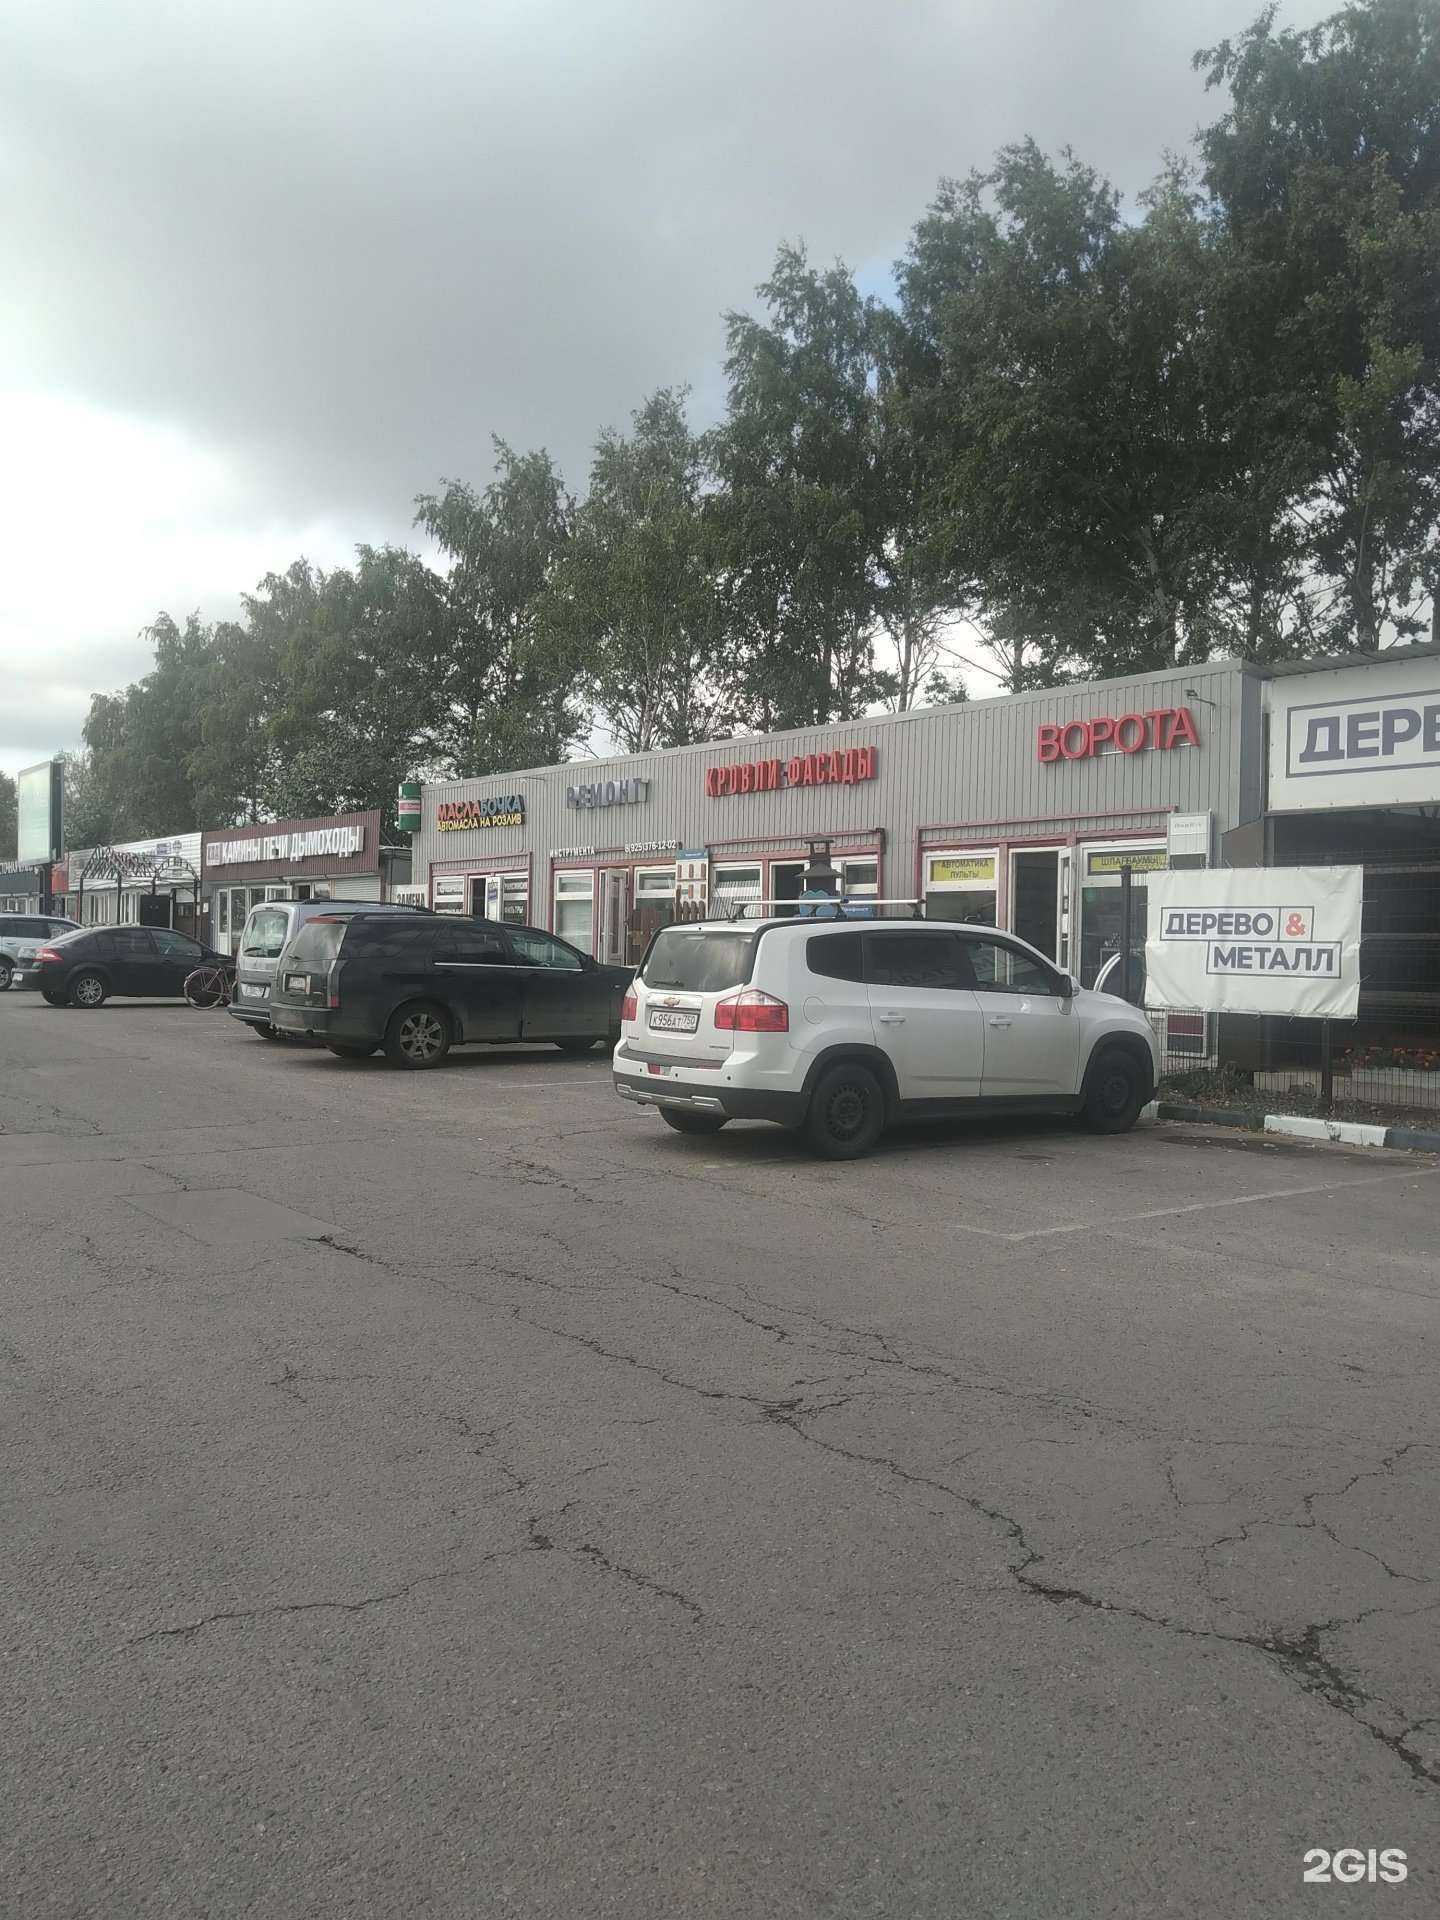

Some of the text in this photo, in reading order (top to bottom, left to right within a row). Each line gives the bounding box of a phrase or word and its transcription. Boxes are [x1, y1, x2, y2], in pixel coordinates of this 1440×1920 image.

[1038, 707, 1200, 763] ВОРОТА
[705, 746, 877, 797] КРОВЛИ ФАСАДЫ
[567, 778, 648, 809] РЕМОНТ
[437, 795, 525, 821] МАСЛАБОЧКА
[437, 813, 522, 832] АВТОМАСЛА НА РОЗЛИВ
[222, 826, 364, 864] КАМИНЫ ПЕЧИ ДЫМОХОДЫ
[550, 846, 595, 858] ИНСТРУМЕНТА
[942, 860, 988, 869] АВТОМАТИКА
[950, 870, 979, 879] ПУЛЬТЫ
[1165, 913, 1306, 937] ДЕРЕВО &
[1213, 946, 1334, 971] МЕТАЛЛ
